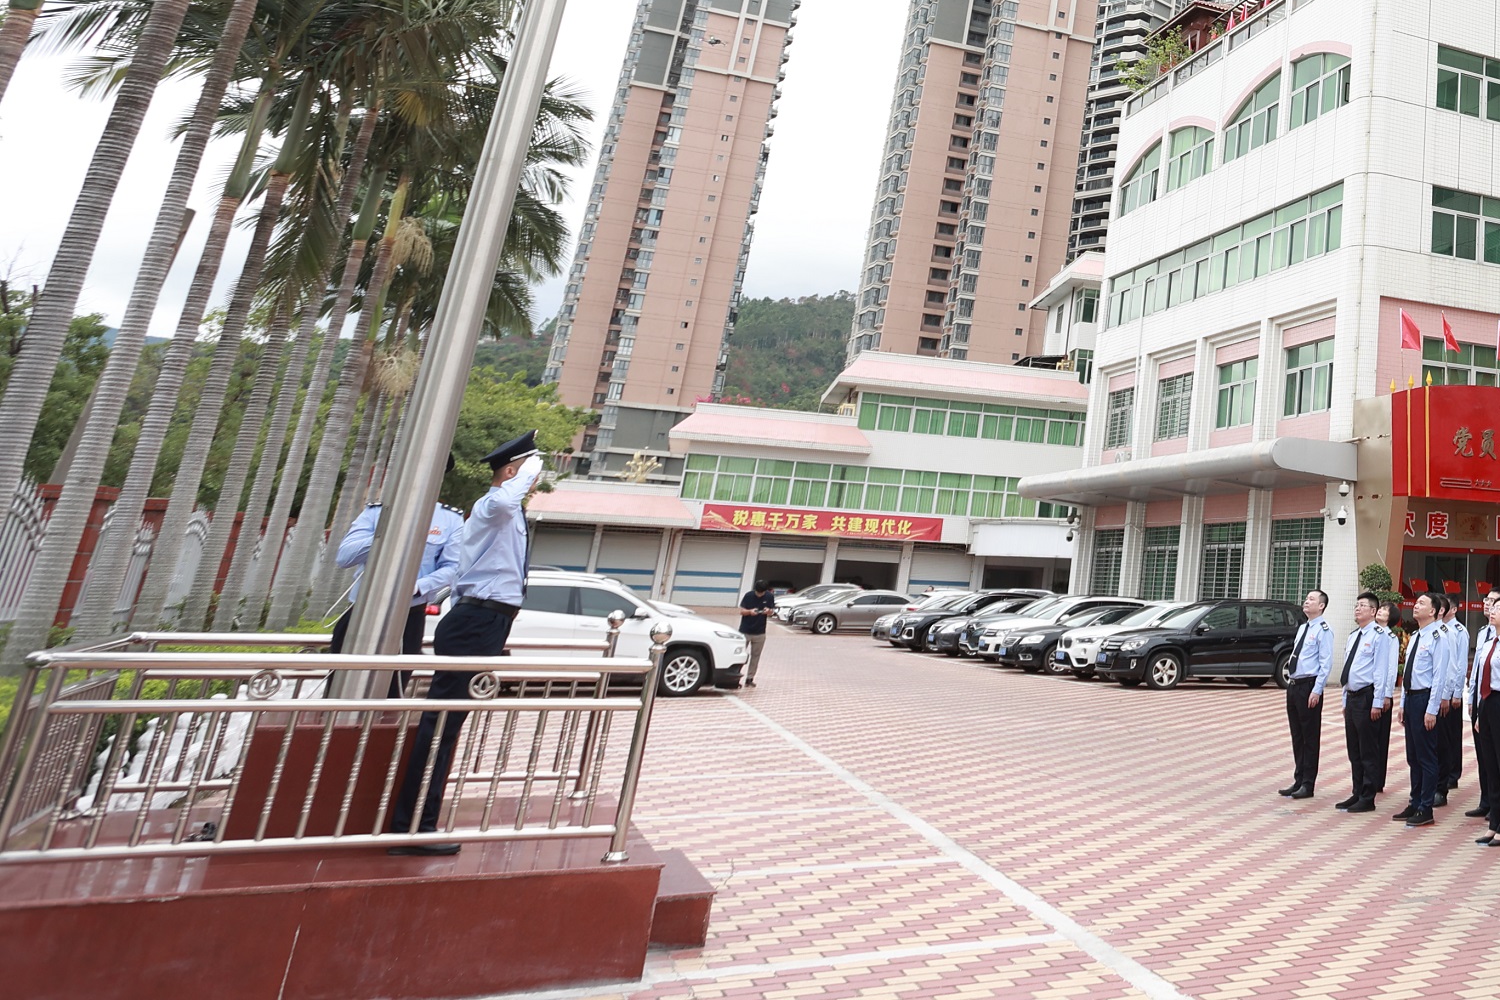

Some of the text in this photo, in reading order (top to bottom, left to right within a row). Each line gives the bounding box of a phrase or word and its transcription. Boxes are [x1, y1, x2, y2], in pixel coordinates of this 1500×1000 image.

[732, 509, 912, 535] 税惠千万家 共建现代化
